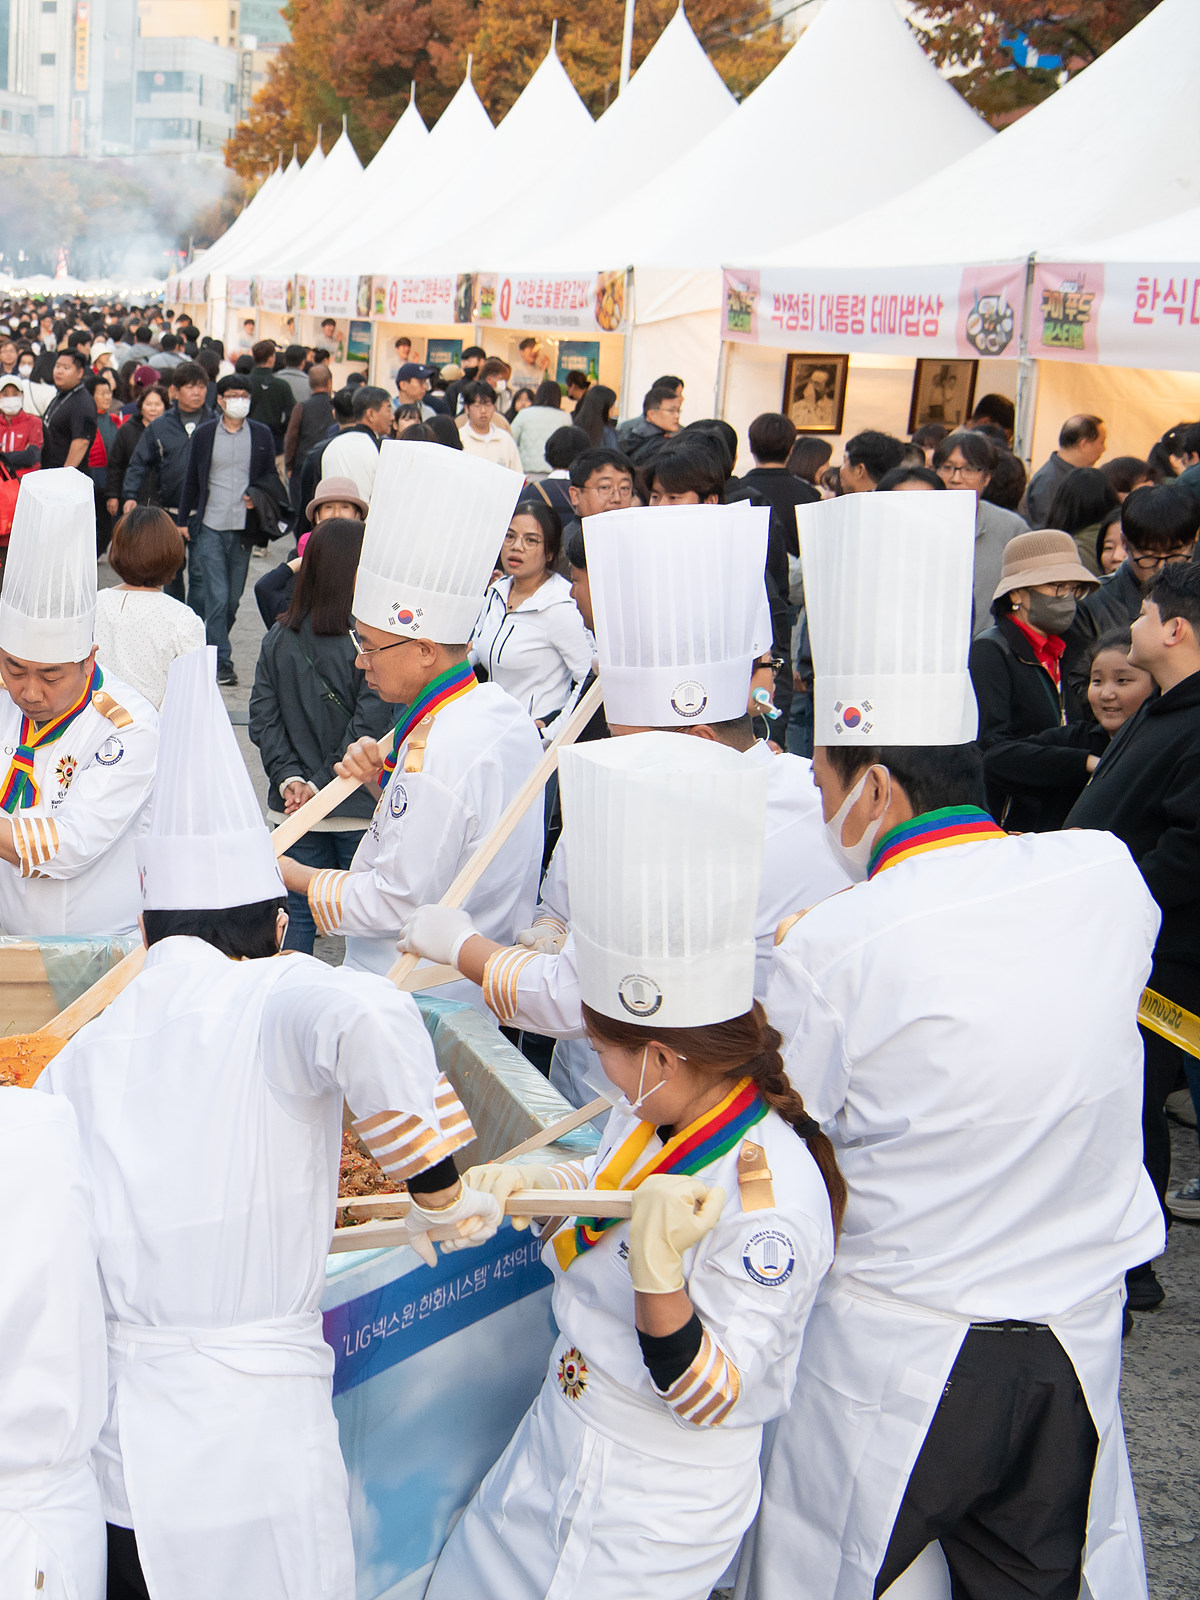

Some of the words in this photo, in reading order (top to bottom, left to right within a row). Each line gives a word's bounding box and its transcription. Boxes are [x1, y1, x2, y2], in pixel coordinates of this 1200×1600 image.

[771, 293, 815, 331] 박정희
[819, 294, 867, 335] 대통령
[871, 294, 944, 337] 테마밥상
[749, 1230, 771, 1243] KOREAN
[493, 1249, 528, 1280] 4천억
